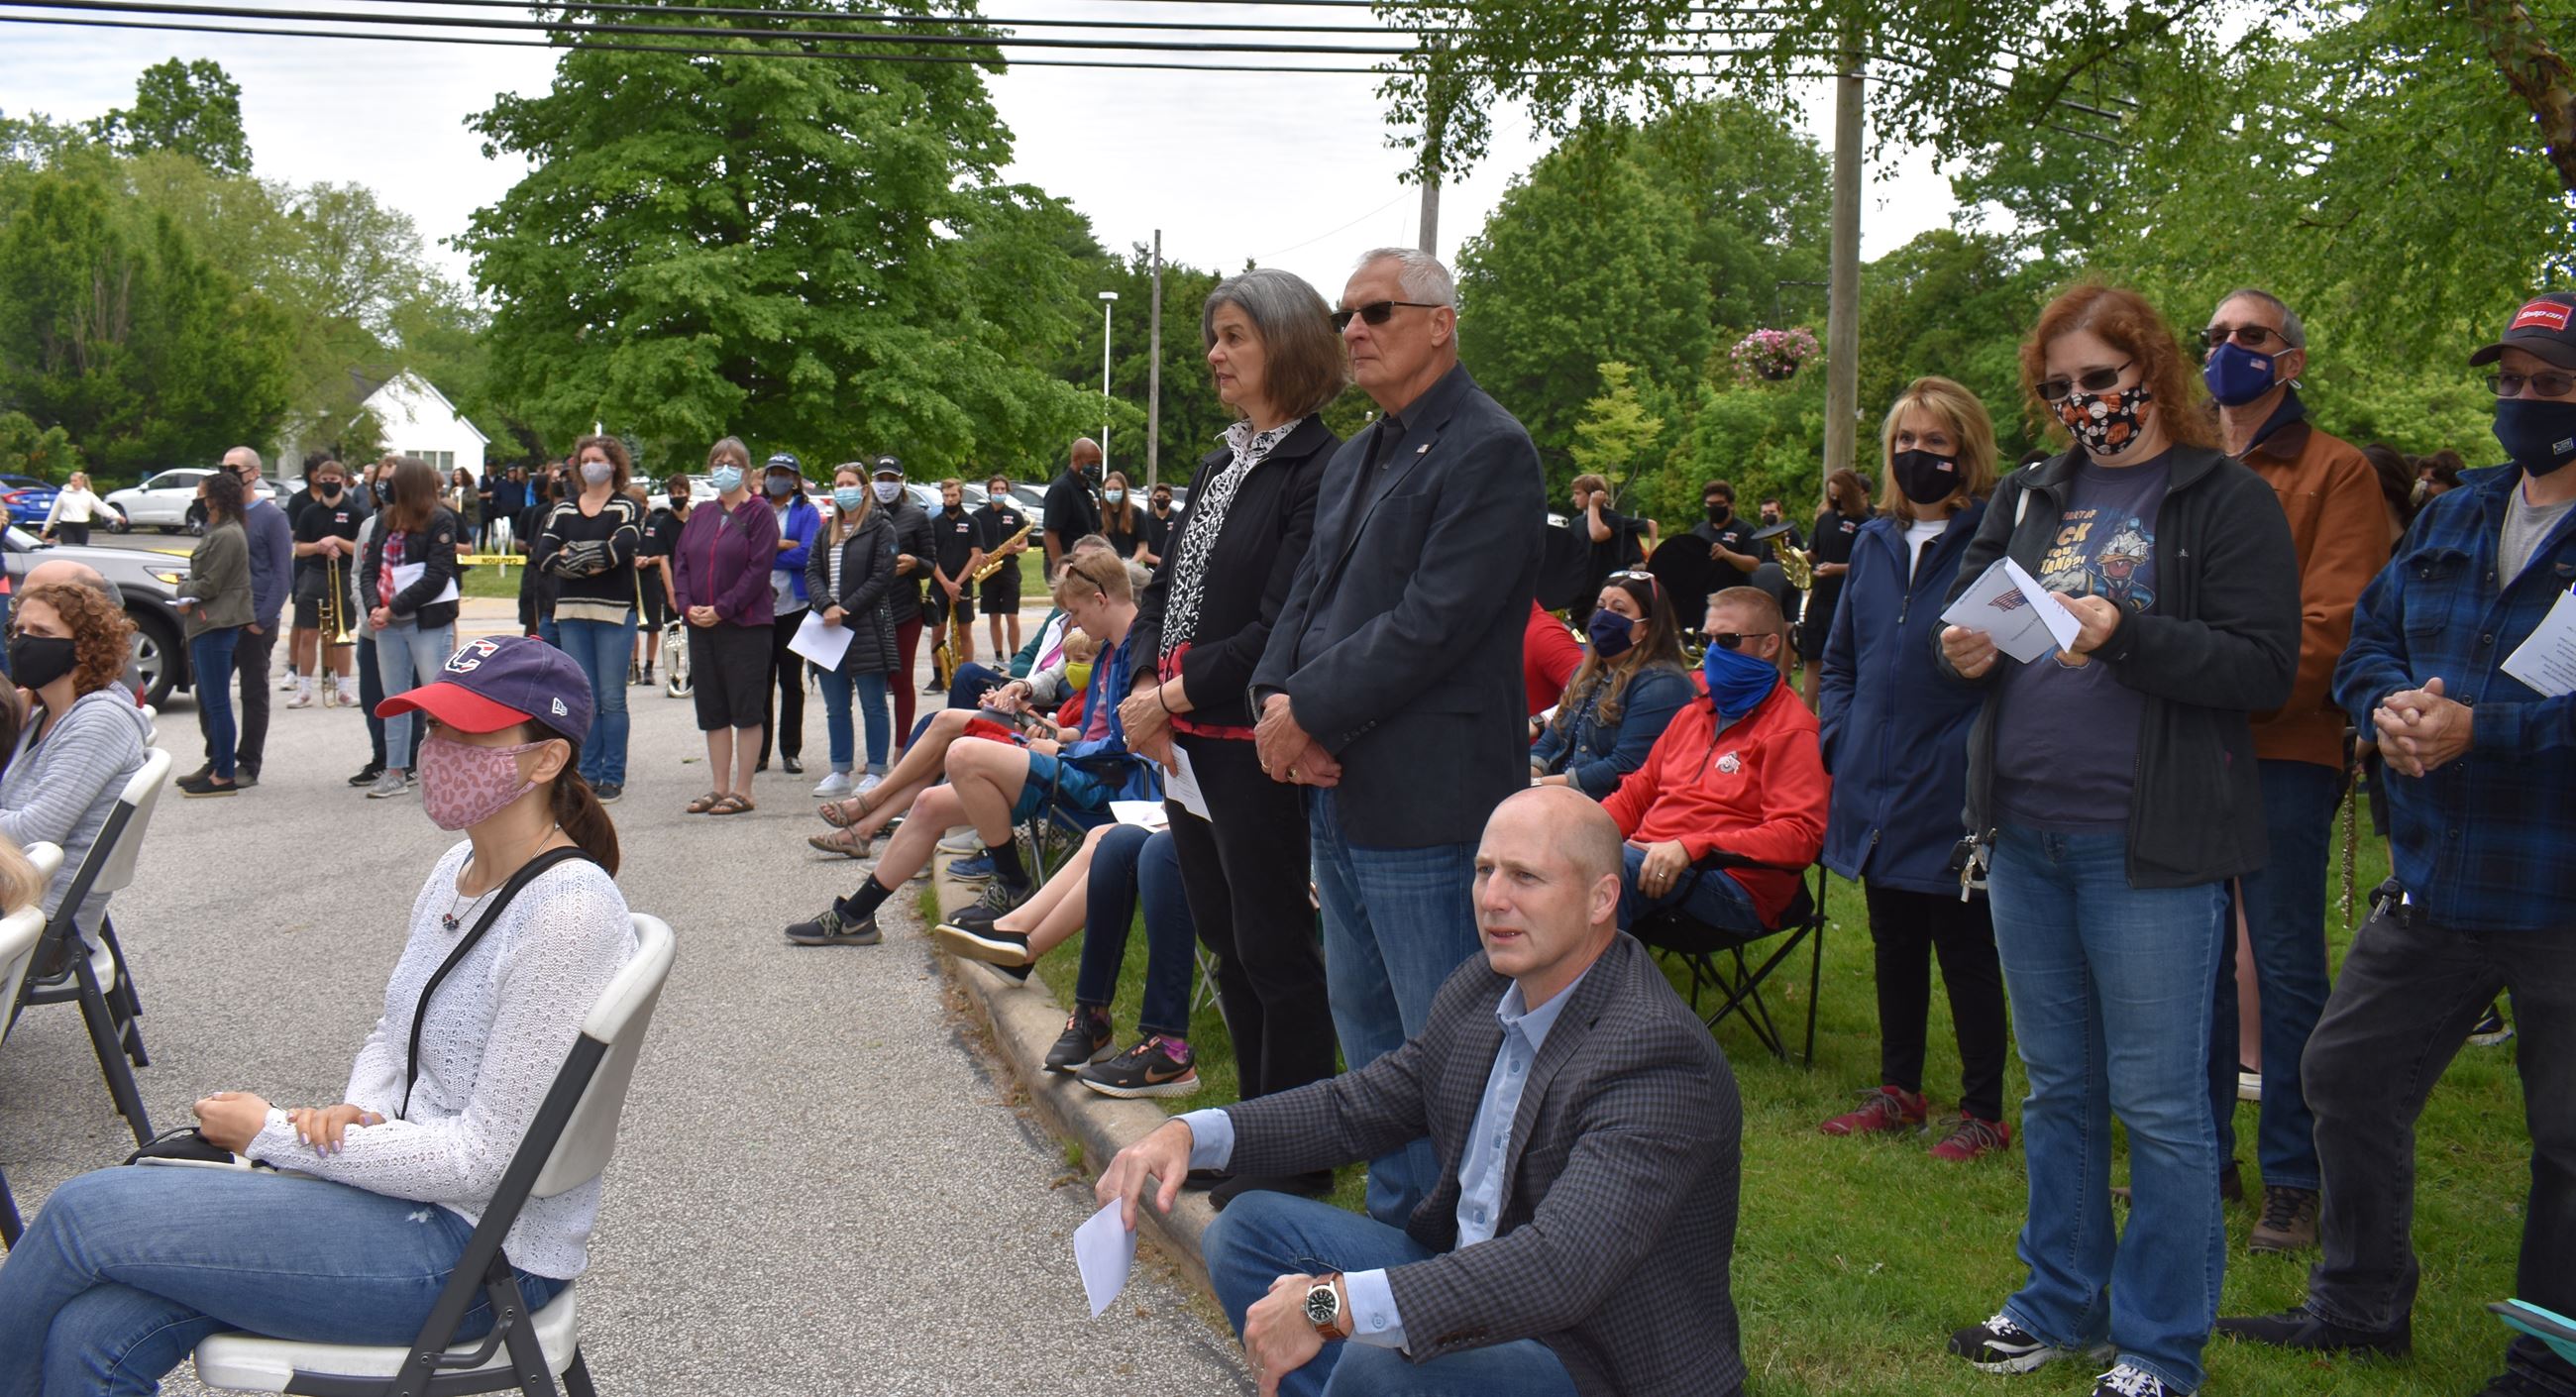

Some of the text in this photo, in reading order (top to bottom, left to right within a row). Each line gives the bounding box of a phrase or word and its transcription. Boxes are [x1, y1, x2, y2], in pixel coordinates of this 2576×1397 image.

[2055, 522, 2093, 546] CK
[2040, 555, 2087, 575] TAND?!
[445, 638, 500, 674] C
